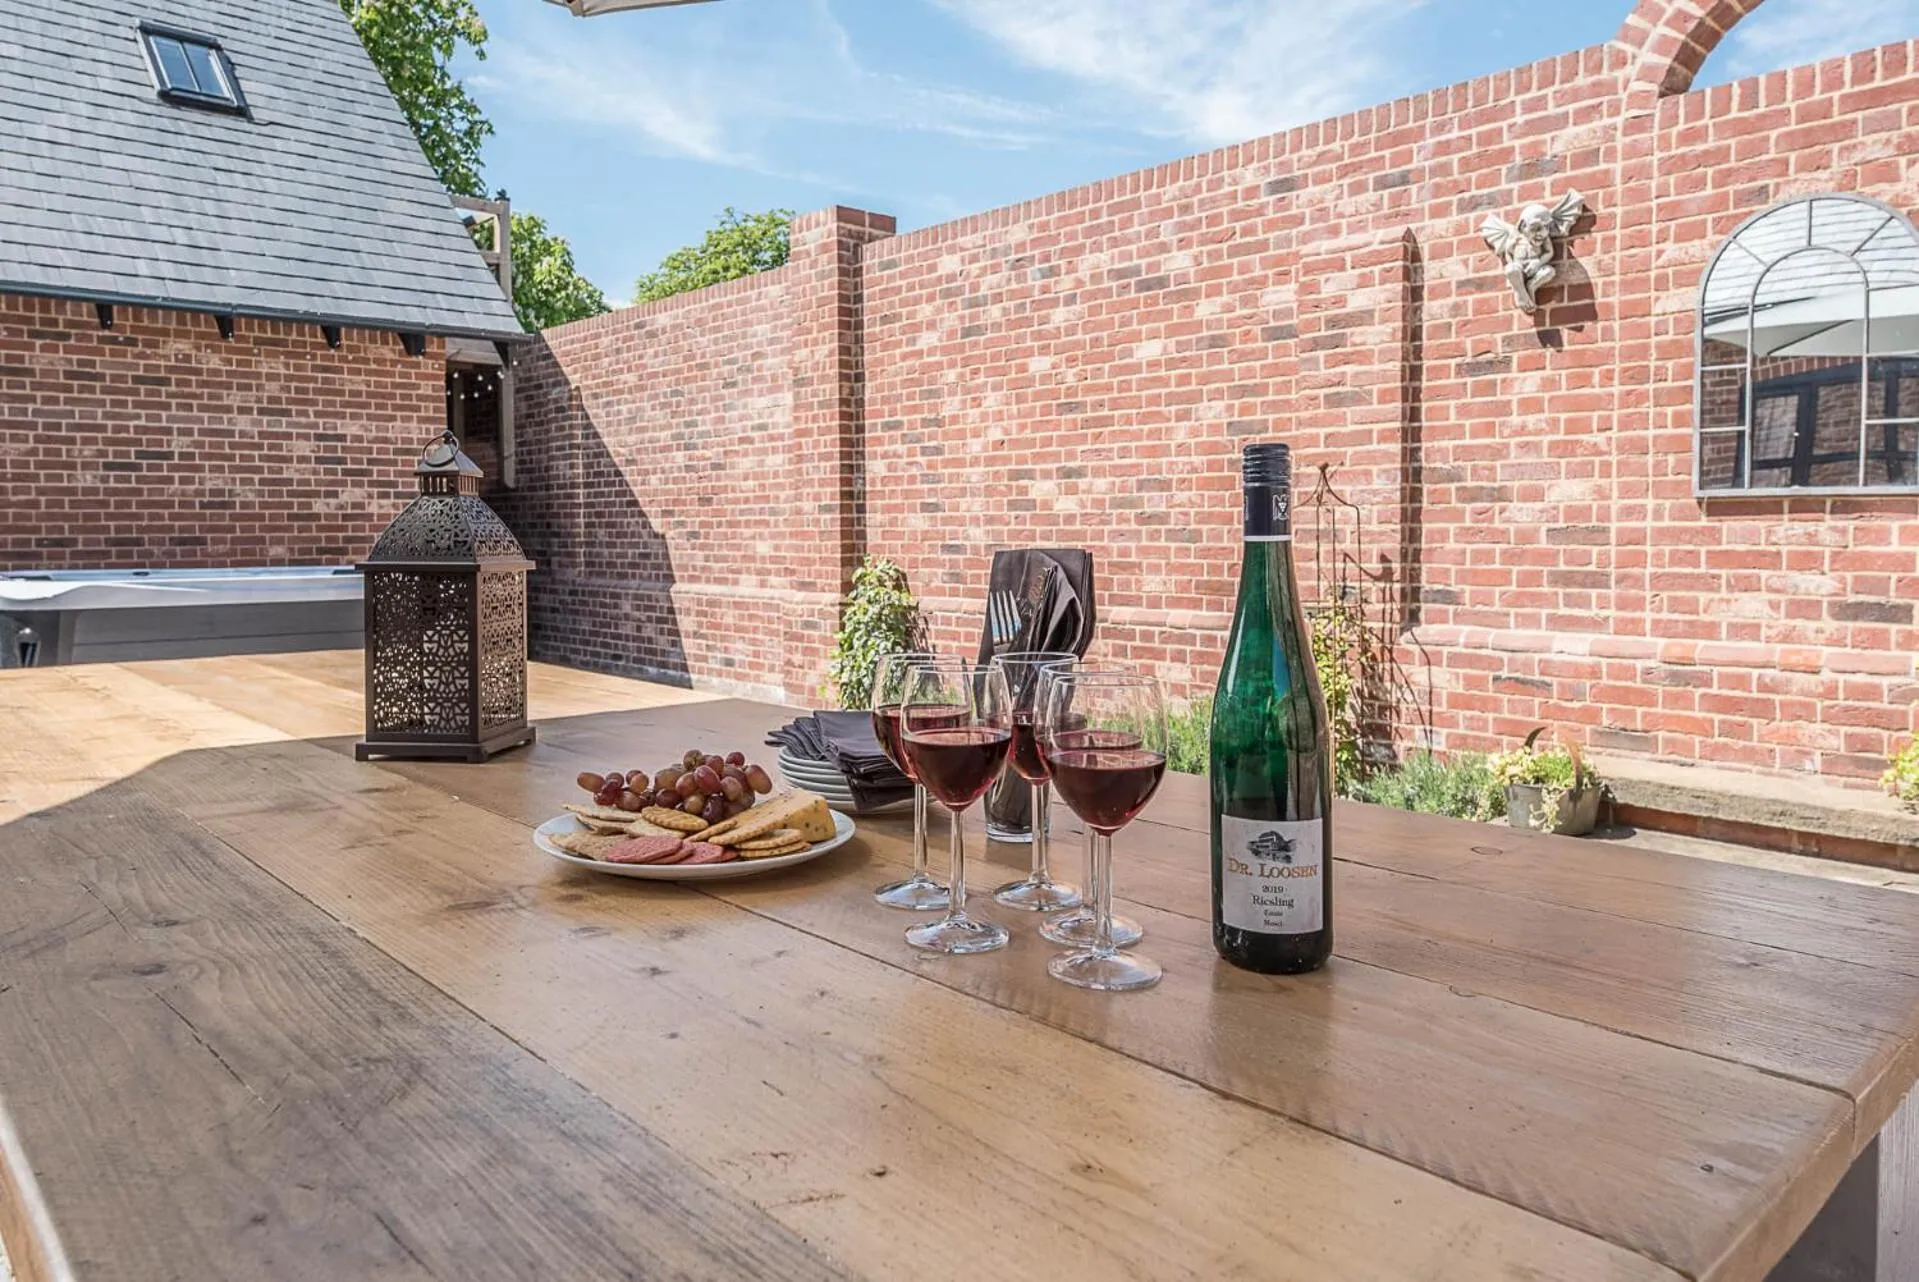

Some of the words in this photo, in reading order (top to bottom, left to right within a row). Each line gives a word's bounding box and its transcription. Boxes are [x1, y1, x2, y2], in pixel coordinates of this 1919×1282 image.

[1228, 858, 1253, 876] DR.
[1259, 863, 1318, 878] LOOSEN
[1262, 885, 1284, 893] 2019
[1252, 895, 1294, 908] Riesling
